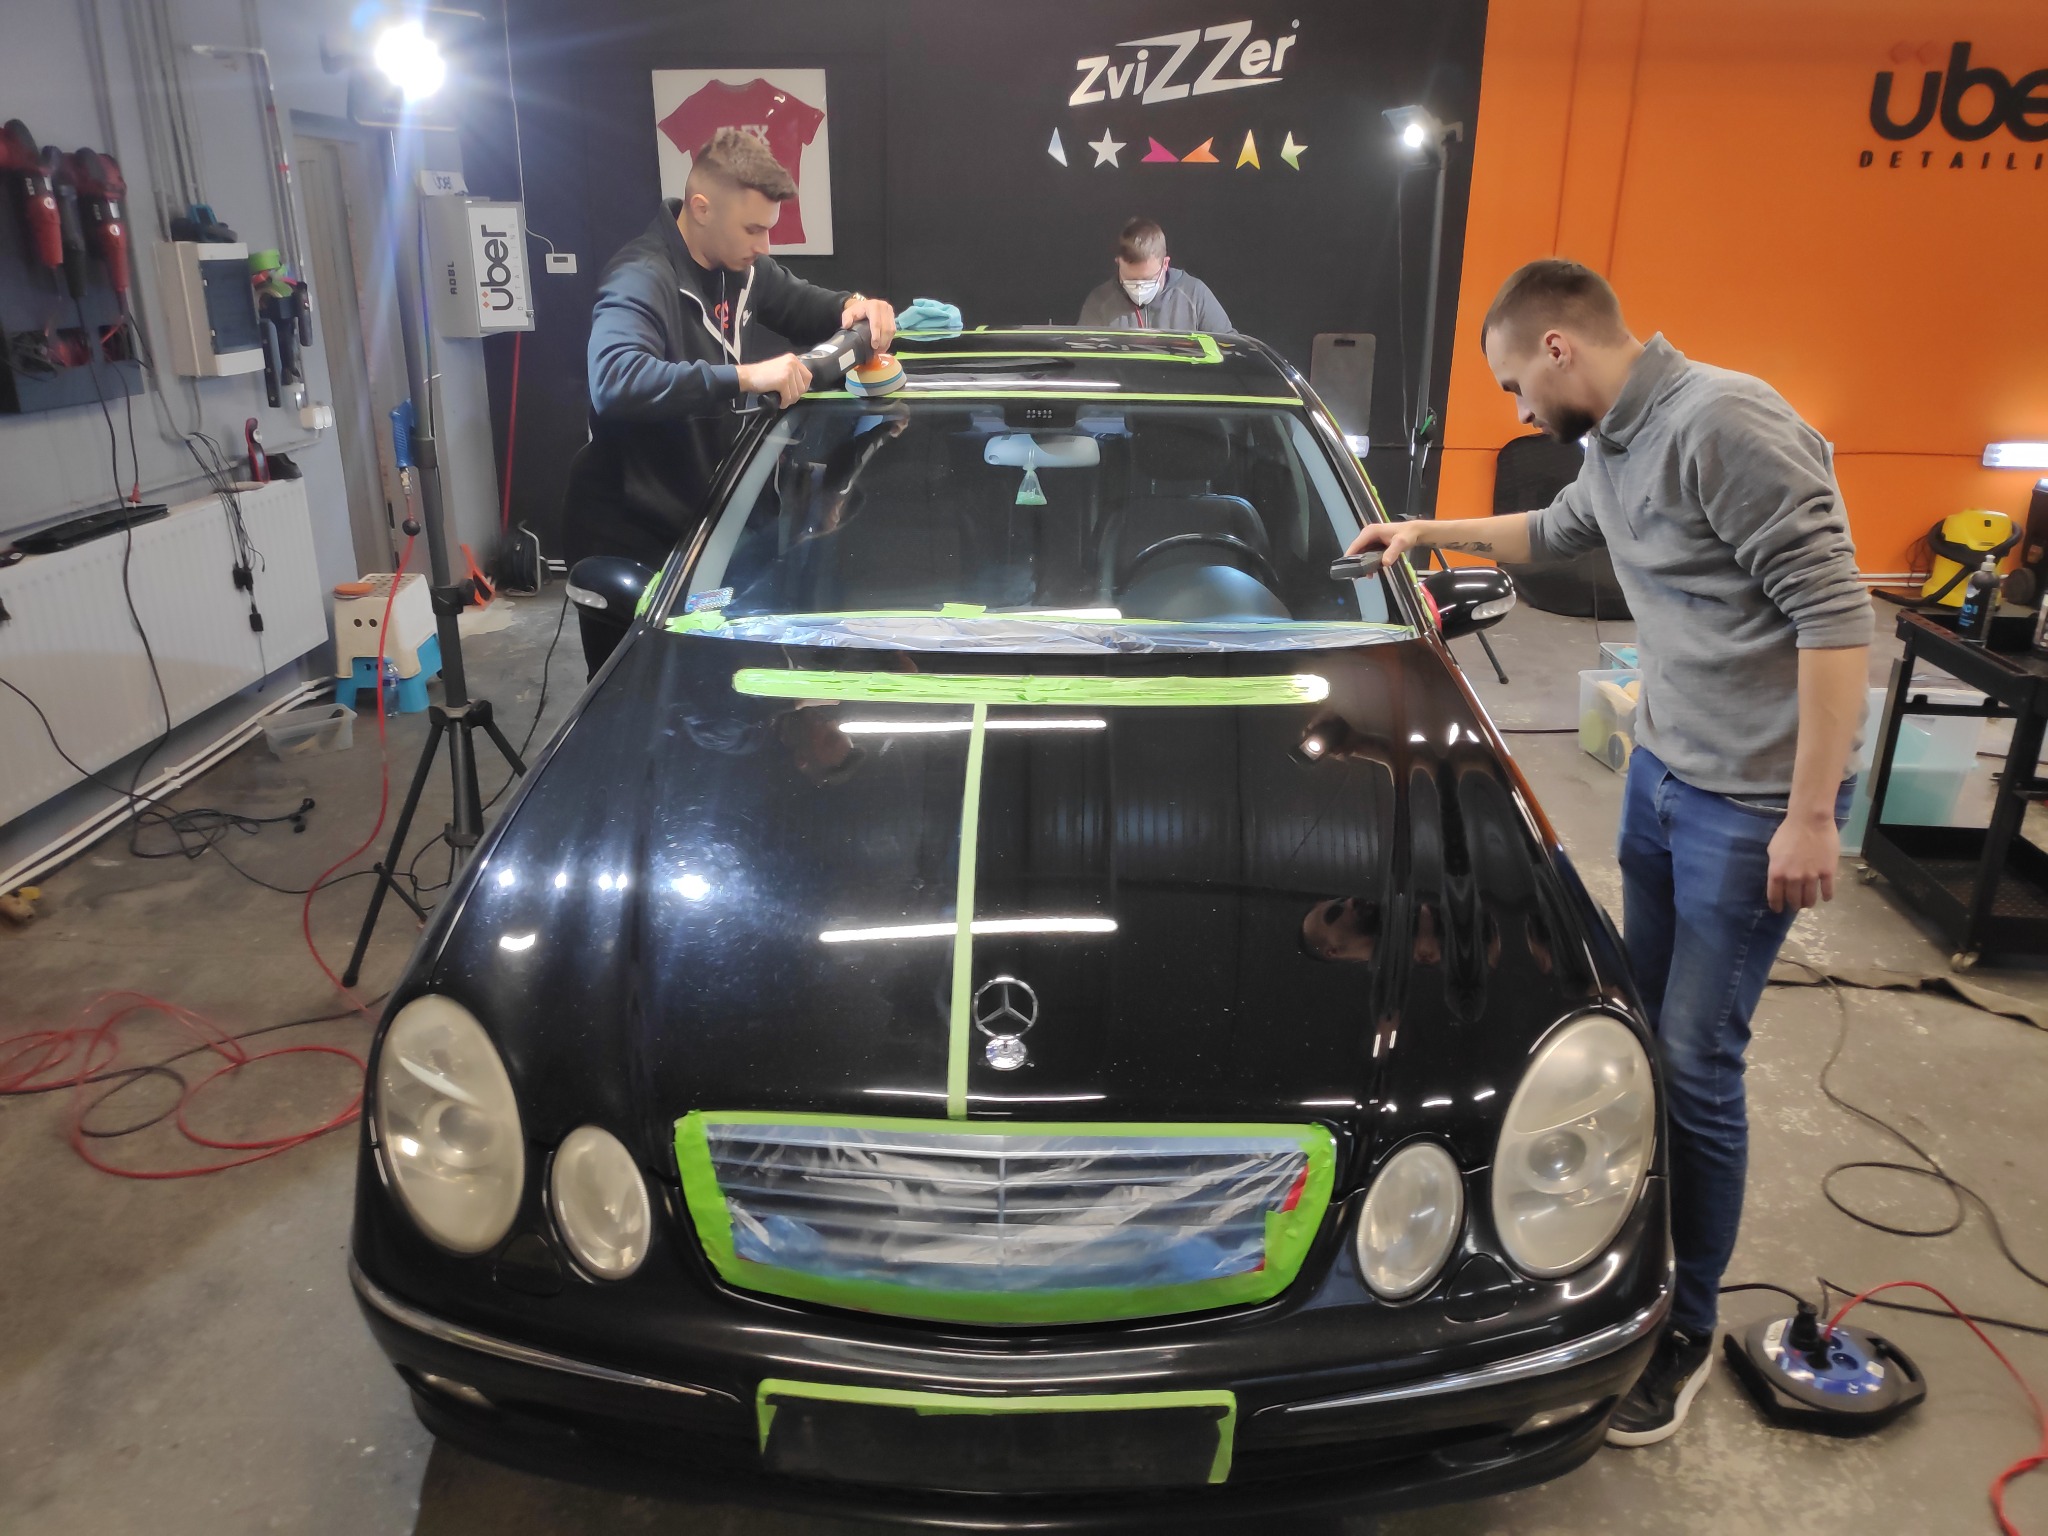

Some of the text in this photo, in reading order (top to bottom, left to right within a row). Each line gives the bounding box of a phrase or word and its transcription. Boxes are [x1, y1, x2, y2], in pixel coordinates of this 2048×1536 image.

[1069, 20, 1297, 106] ZviZZer
[447, 261, 458, 295] ADBL
[479, 224, 514, 311] über
